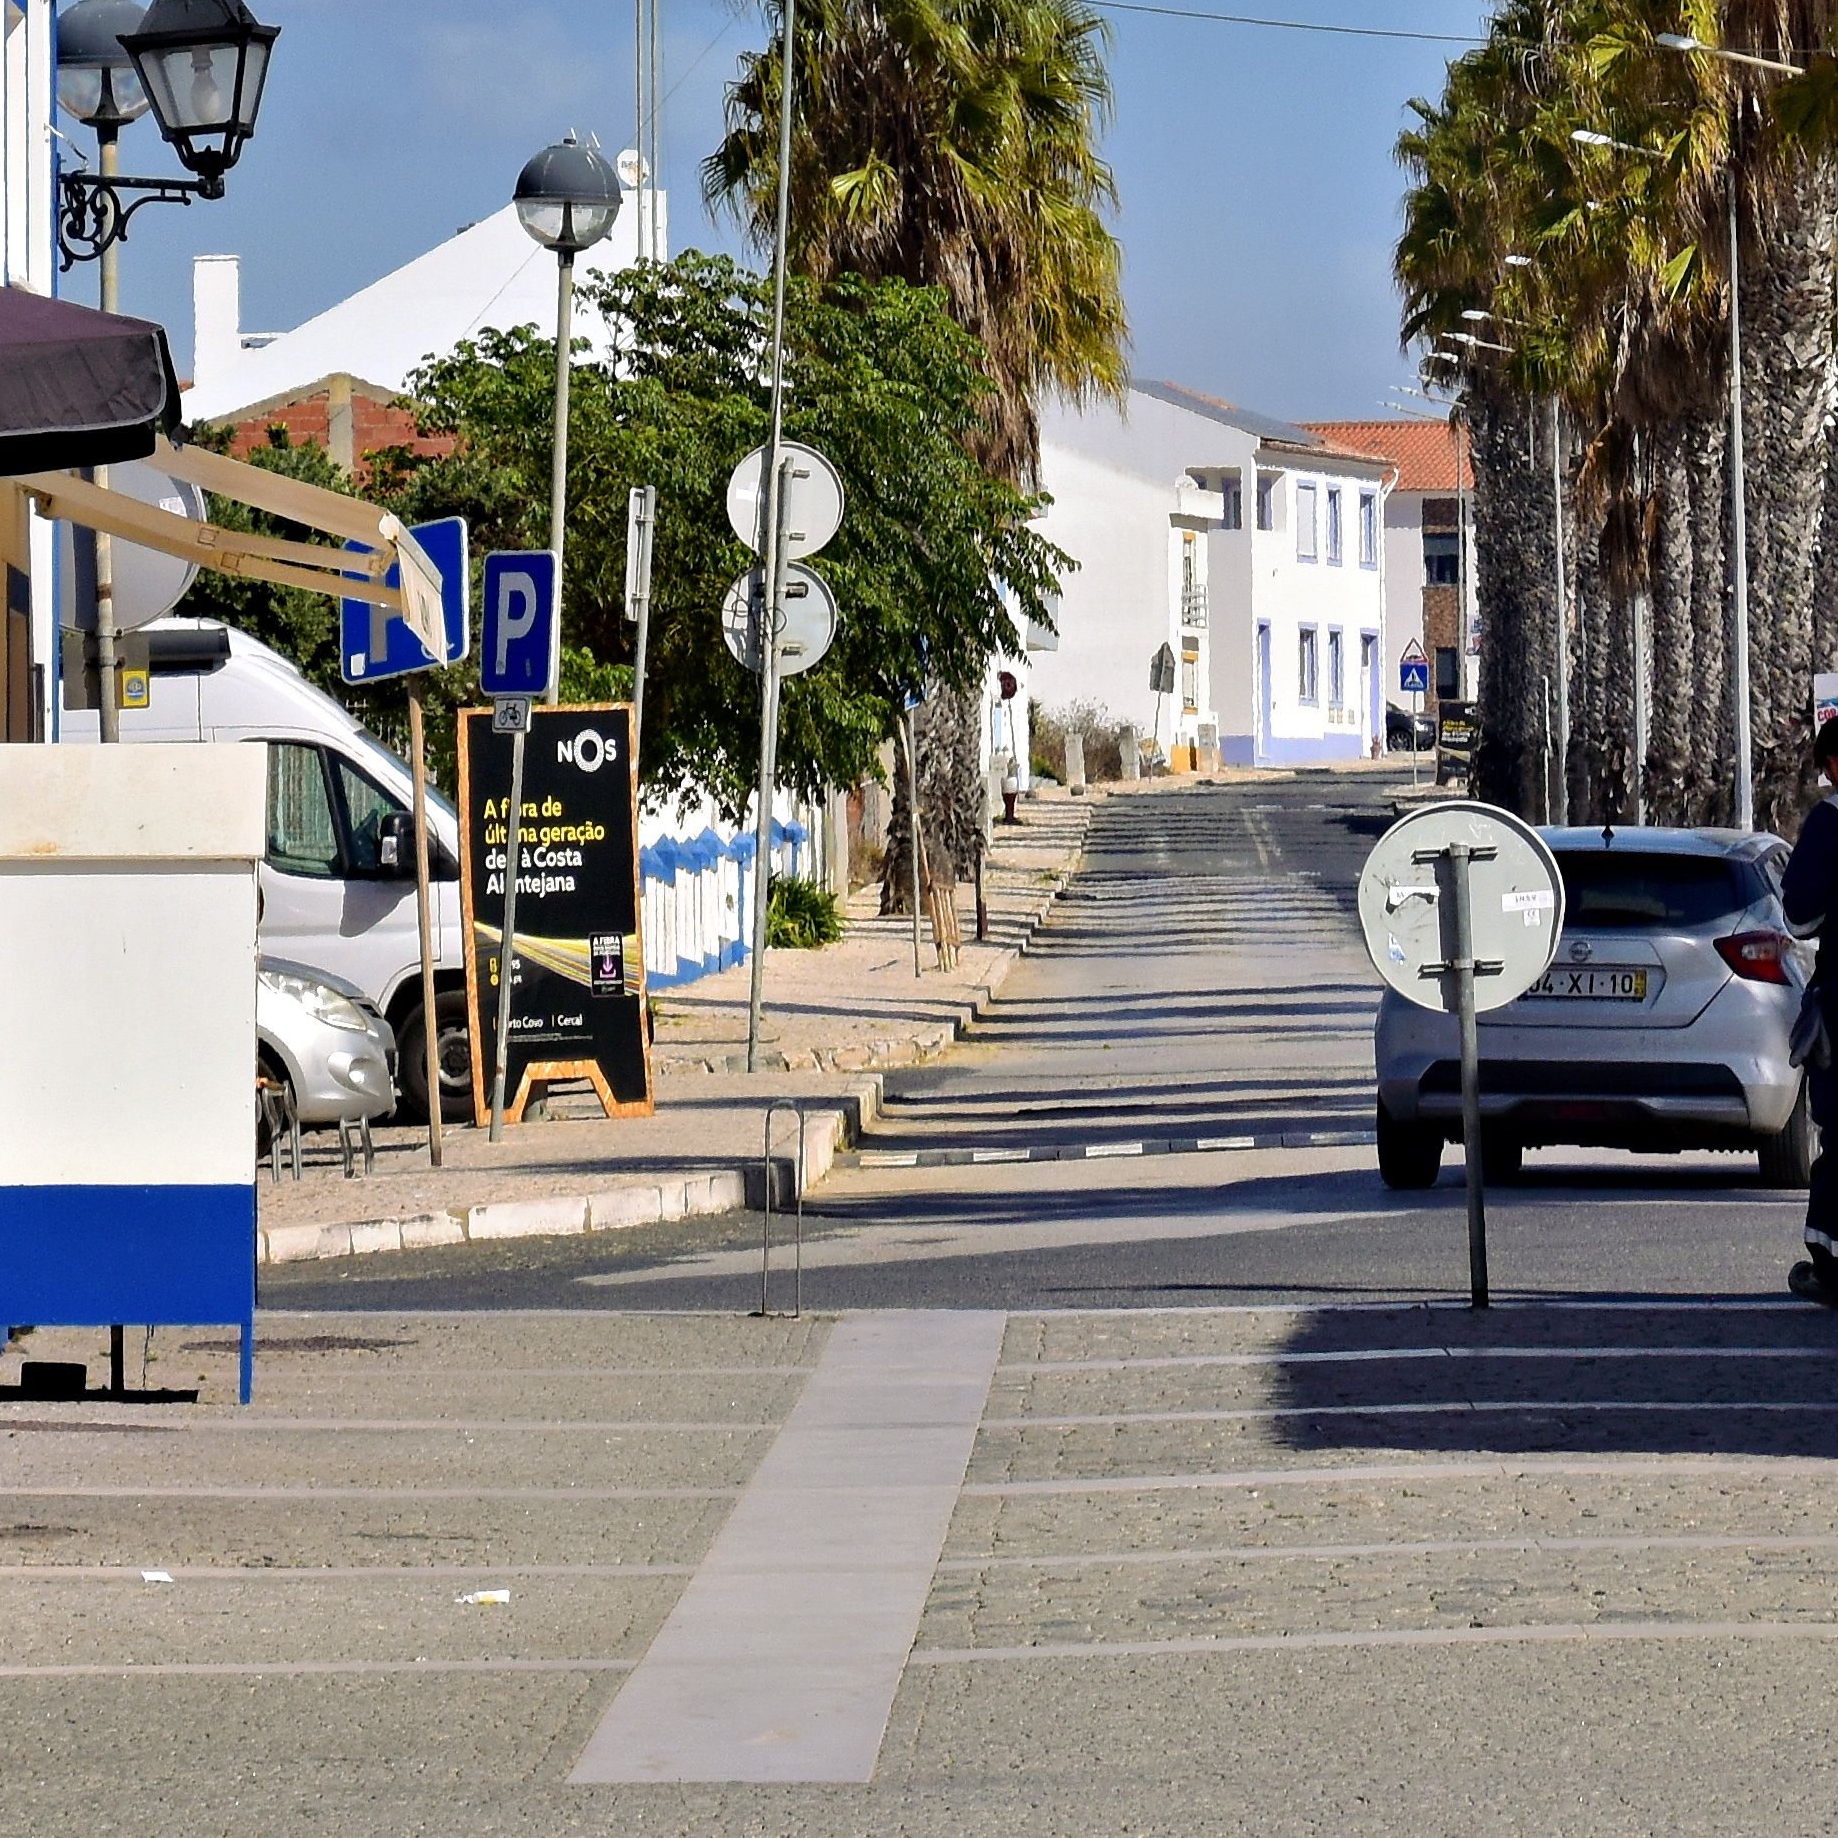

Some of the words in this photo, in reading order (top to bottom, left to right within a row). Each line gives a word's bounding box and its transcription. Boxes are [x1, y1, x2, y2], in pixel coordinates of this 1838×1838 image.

[495, 571, 538, 676] P
[557, 728, 617, 773] NOS
[484, 799, 497, 819] A
[501, 797, 538, 819] fra
[542, 795, 562, 817] de
[485, 823, 538, 844] últma
[540, 821, 605, 847] geração
[521, 847, 531, 868] à
[534, 847, 583, 868] Costa
[486, 872, 576, 898] Alntejana
